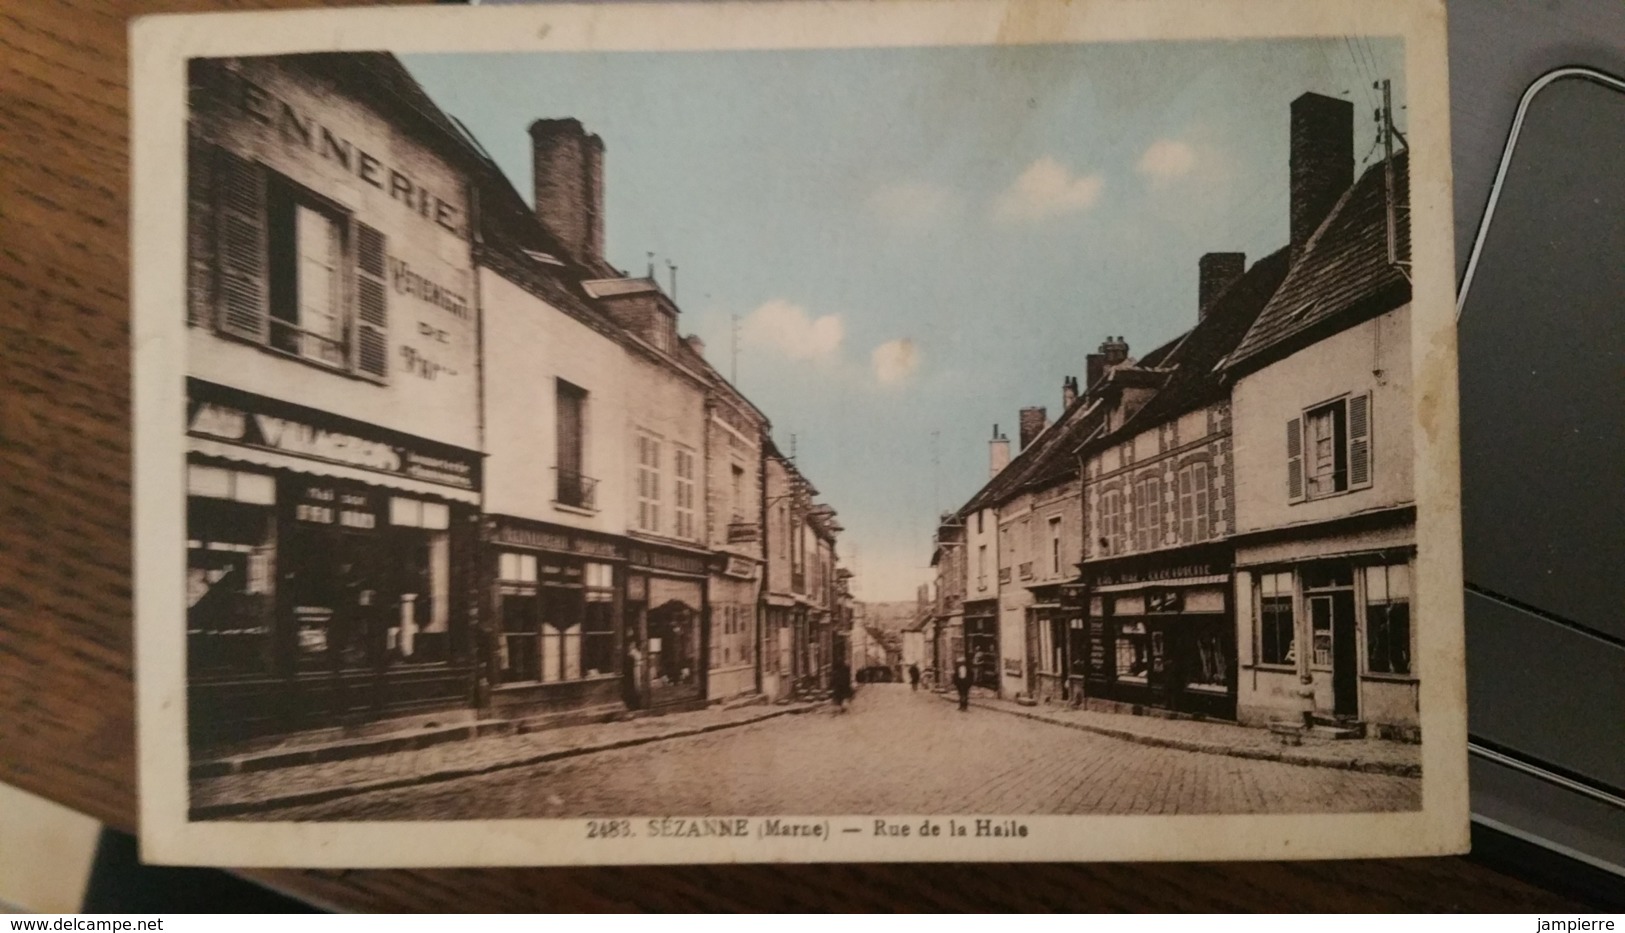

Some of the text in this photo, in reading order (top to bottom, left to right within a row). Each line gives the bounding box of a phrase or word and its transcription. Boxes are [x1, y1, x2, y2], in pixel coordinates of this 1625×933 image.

[647, 814, 749, 838] SÉZANNE
[757, 819, 829, 841] (Marne)
[873, 819, 911, 837] Rue
[919, 819, 942, 837] de
[949, 819, 967, 837] la
